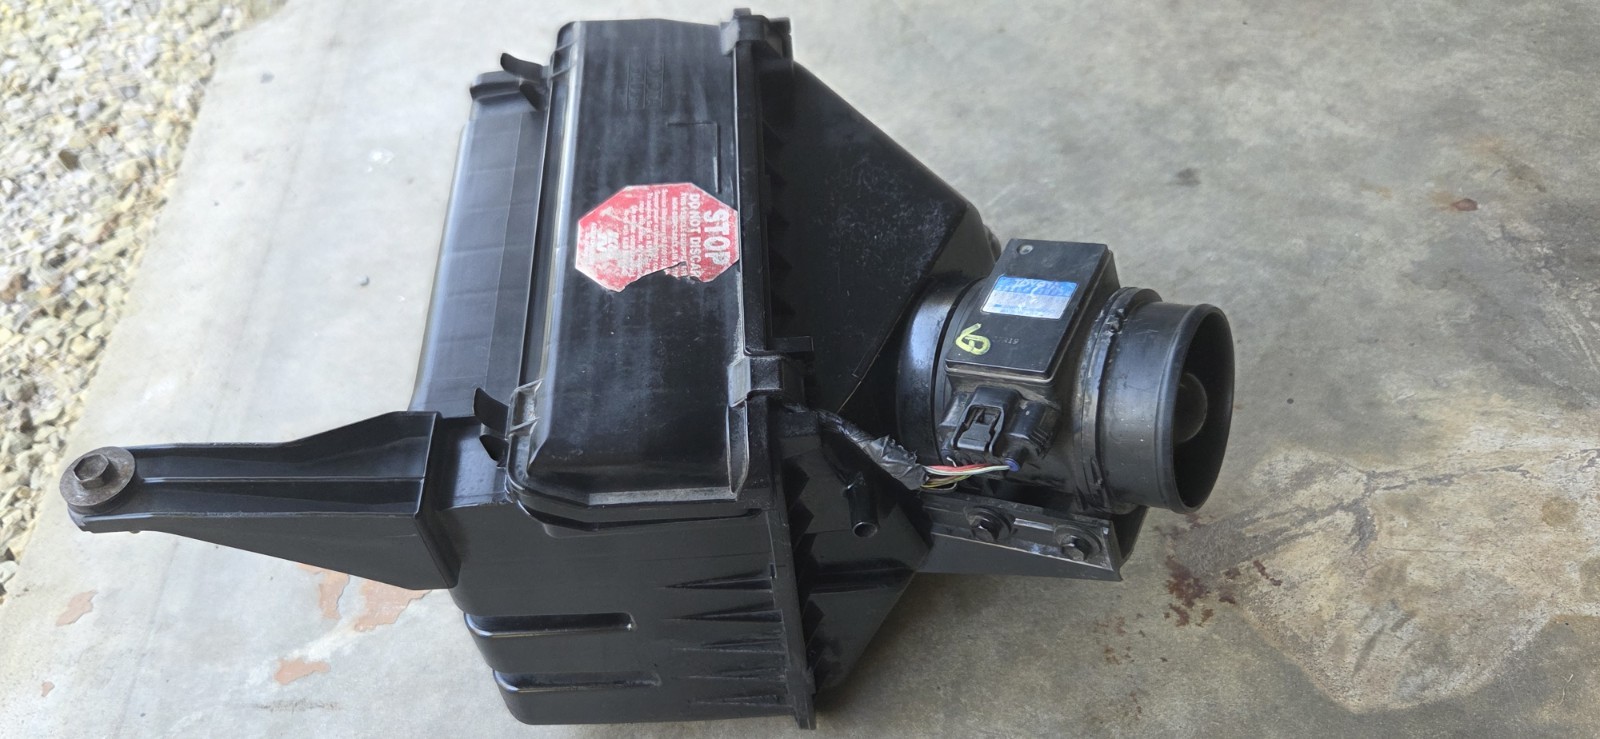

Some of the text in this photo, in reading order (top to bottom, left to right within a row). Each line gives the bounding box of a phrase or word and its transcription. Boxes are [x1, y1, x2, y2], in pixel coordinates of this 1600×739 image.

[688, 193, 702, 278] DO NOT DISCAR
[703, 209, 730, 265] STOP
